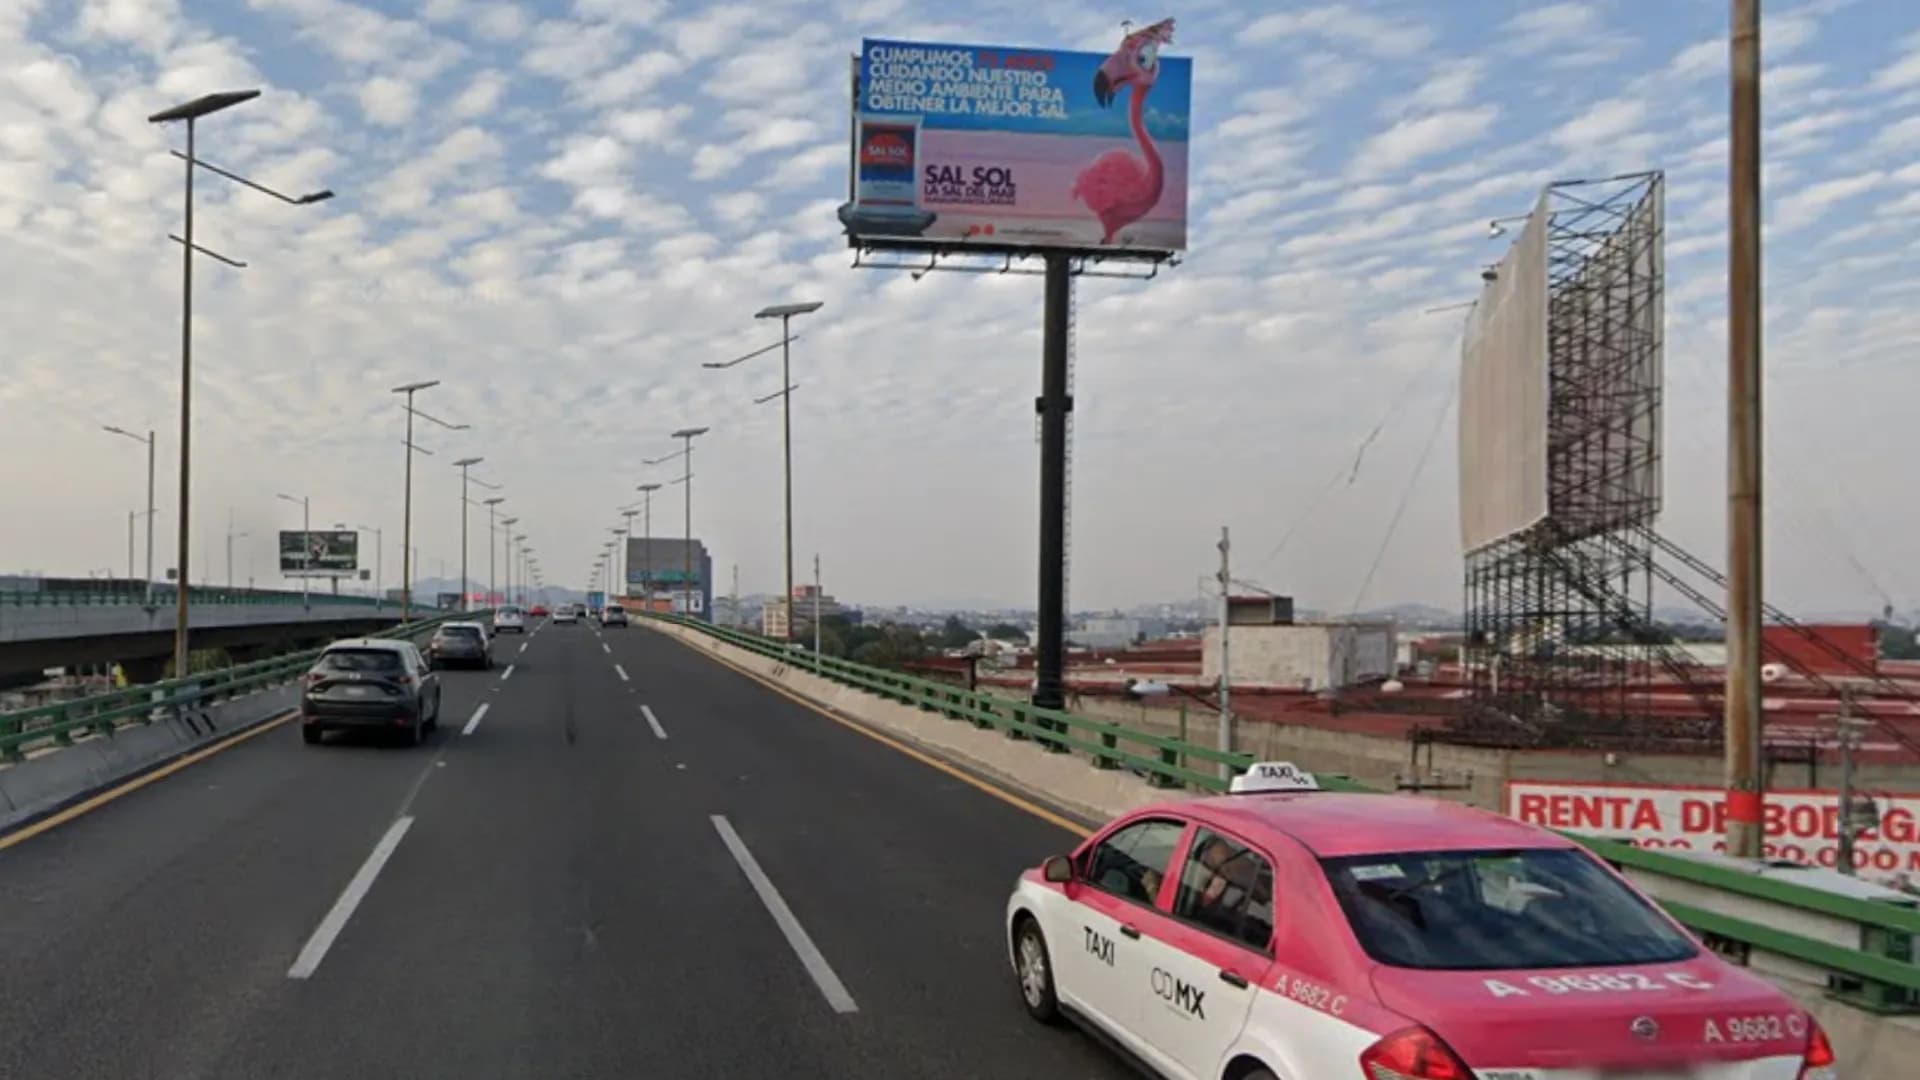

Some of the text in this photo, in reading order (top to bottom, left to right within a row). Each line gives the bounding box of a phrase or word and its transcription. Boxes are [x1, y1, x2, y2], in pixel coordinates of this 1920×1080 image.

[869, 63, 1047, 87] CUIDANDO NUESTRO
[869, 79, 1064, 103] MEDIO AMBIENTE PARA
[869, 95, 945, 112] OBTENER
[951, 98, 970, 113] LA
[974, 100, 1032, 117] MEJOR
[925, 165, 1015, 187] SAL SOL
[924, 185, 1015, 198] LA SAL DEL MAR
[1259, 766, 1293, 778] TAXI
[1520, 793, 1662, 831] RENTA
[1084, 925, 1115, 967] TAXI
[1151, 967, 1206, 1020] CDMX
[1274, 974, 1348, 1015] A 9682 C
[1484, 972, 1714, 998] A 9682 C
[1704, 1014, 1806, 1042] A 9682 C
